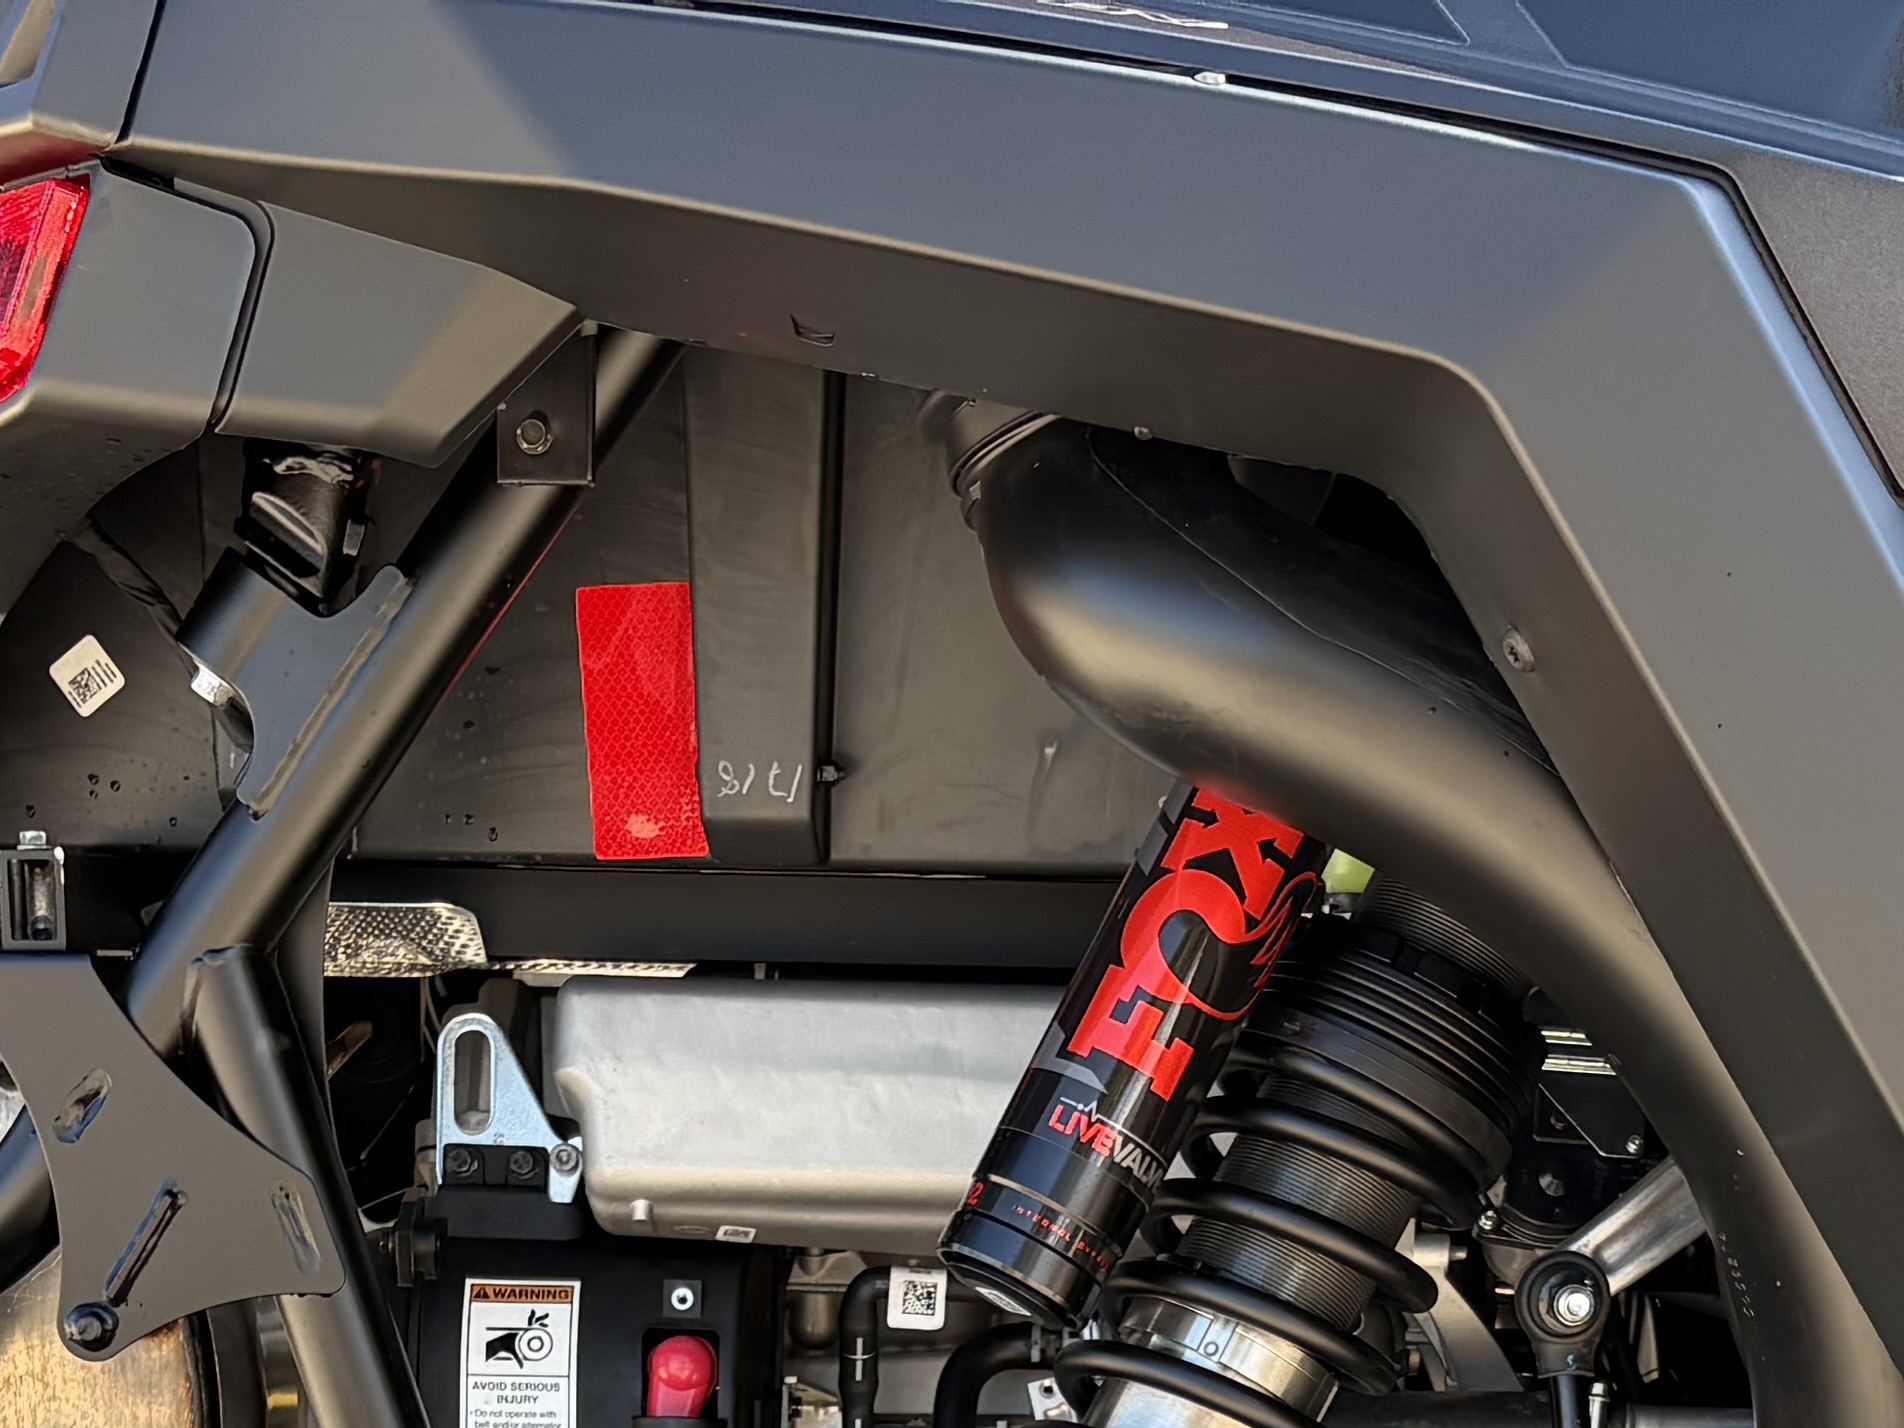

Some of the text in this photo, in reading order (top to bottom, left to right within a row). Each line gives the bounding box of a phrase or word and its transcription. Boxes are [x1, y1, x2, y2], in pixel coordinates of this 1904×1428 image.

[1067, 785, 1320, 1101] FOX
[492, 1287, 570, 1301] WARNING
[472, 1380, 561, 1392] AVOID SERIOUS
[496, 1394, 539, 1405] INJURY
[474, 1408, 557, 1419] Do not operate with
[474, 1420, 491, 1428] belt
[492, 1420, 520, 1428] and/or
